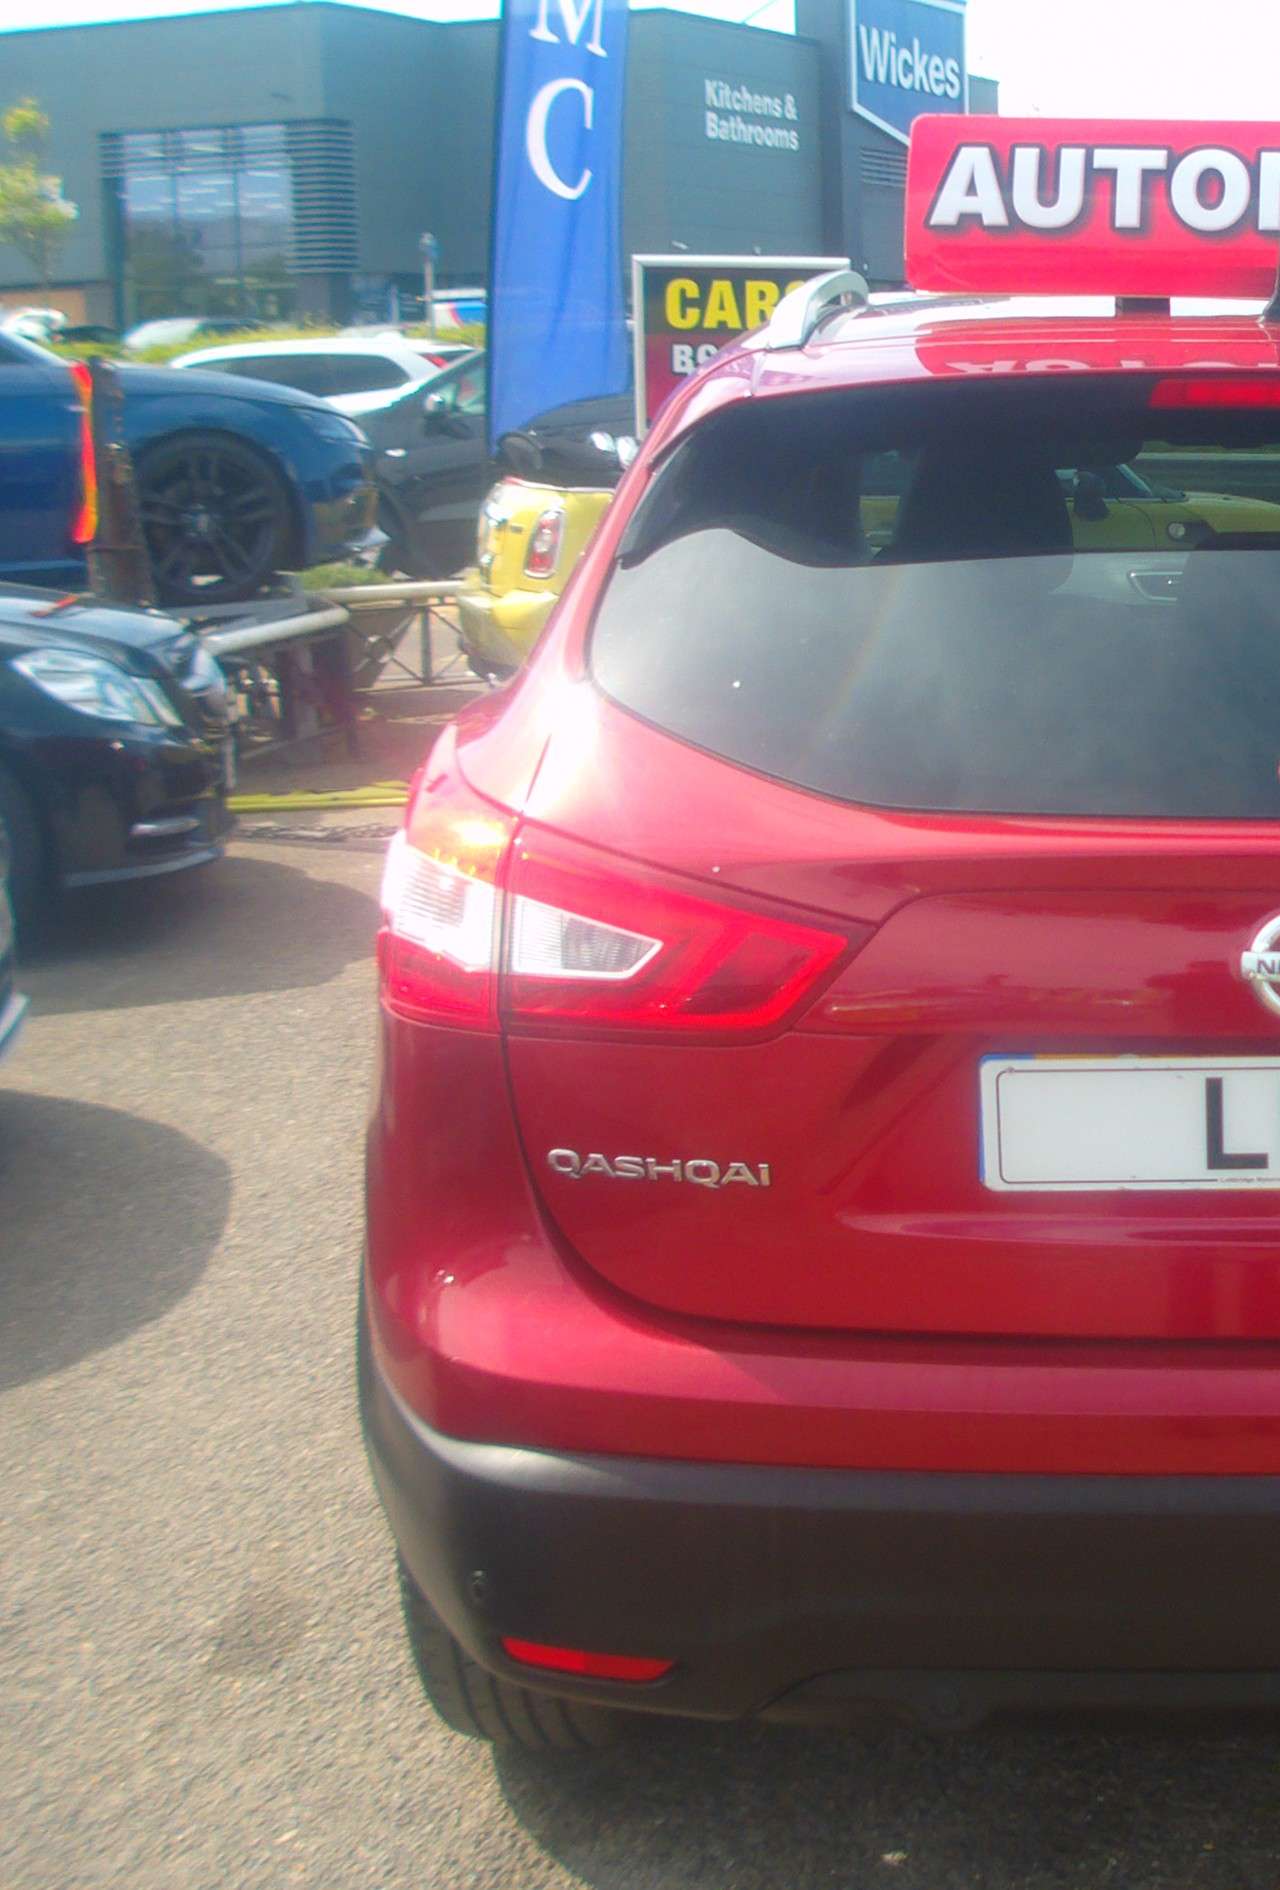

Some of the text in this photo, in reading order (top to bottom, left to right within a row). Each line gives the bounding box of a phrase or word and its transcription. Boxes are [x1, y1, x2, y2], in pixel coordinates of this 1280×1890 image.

[858, 24, 962, 99] Wickes
[704, 79, 799, 121] Kitchens &
[705, 111, 800, 151] Bathrooms
